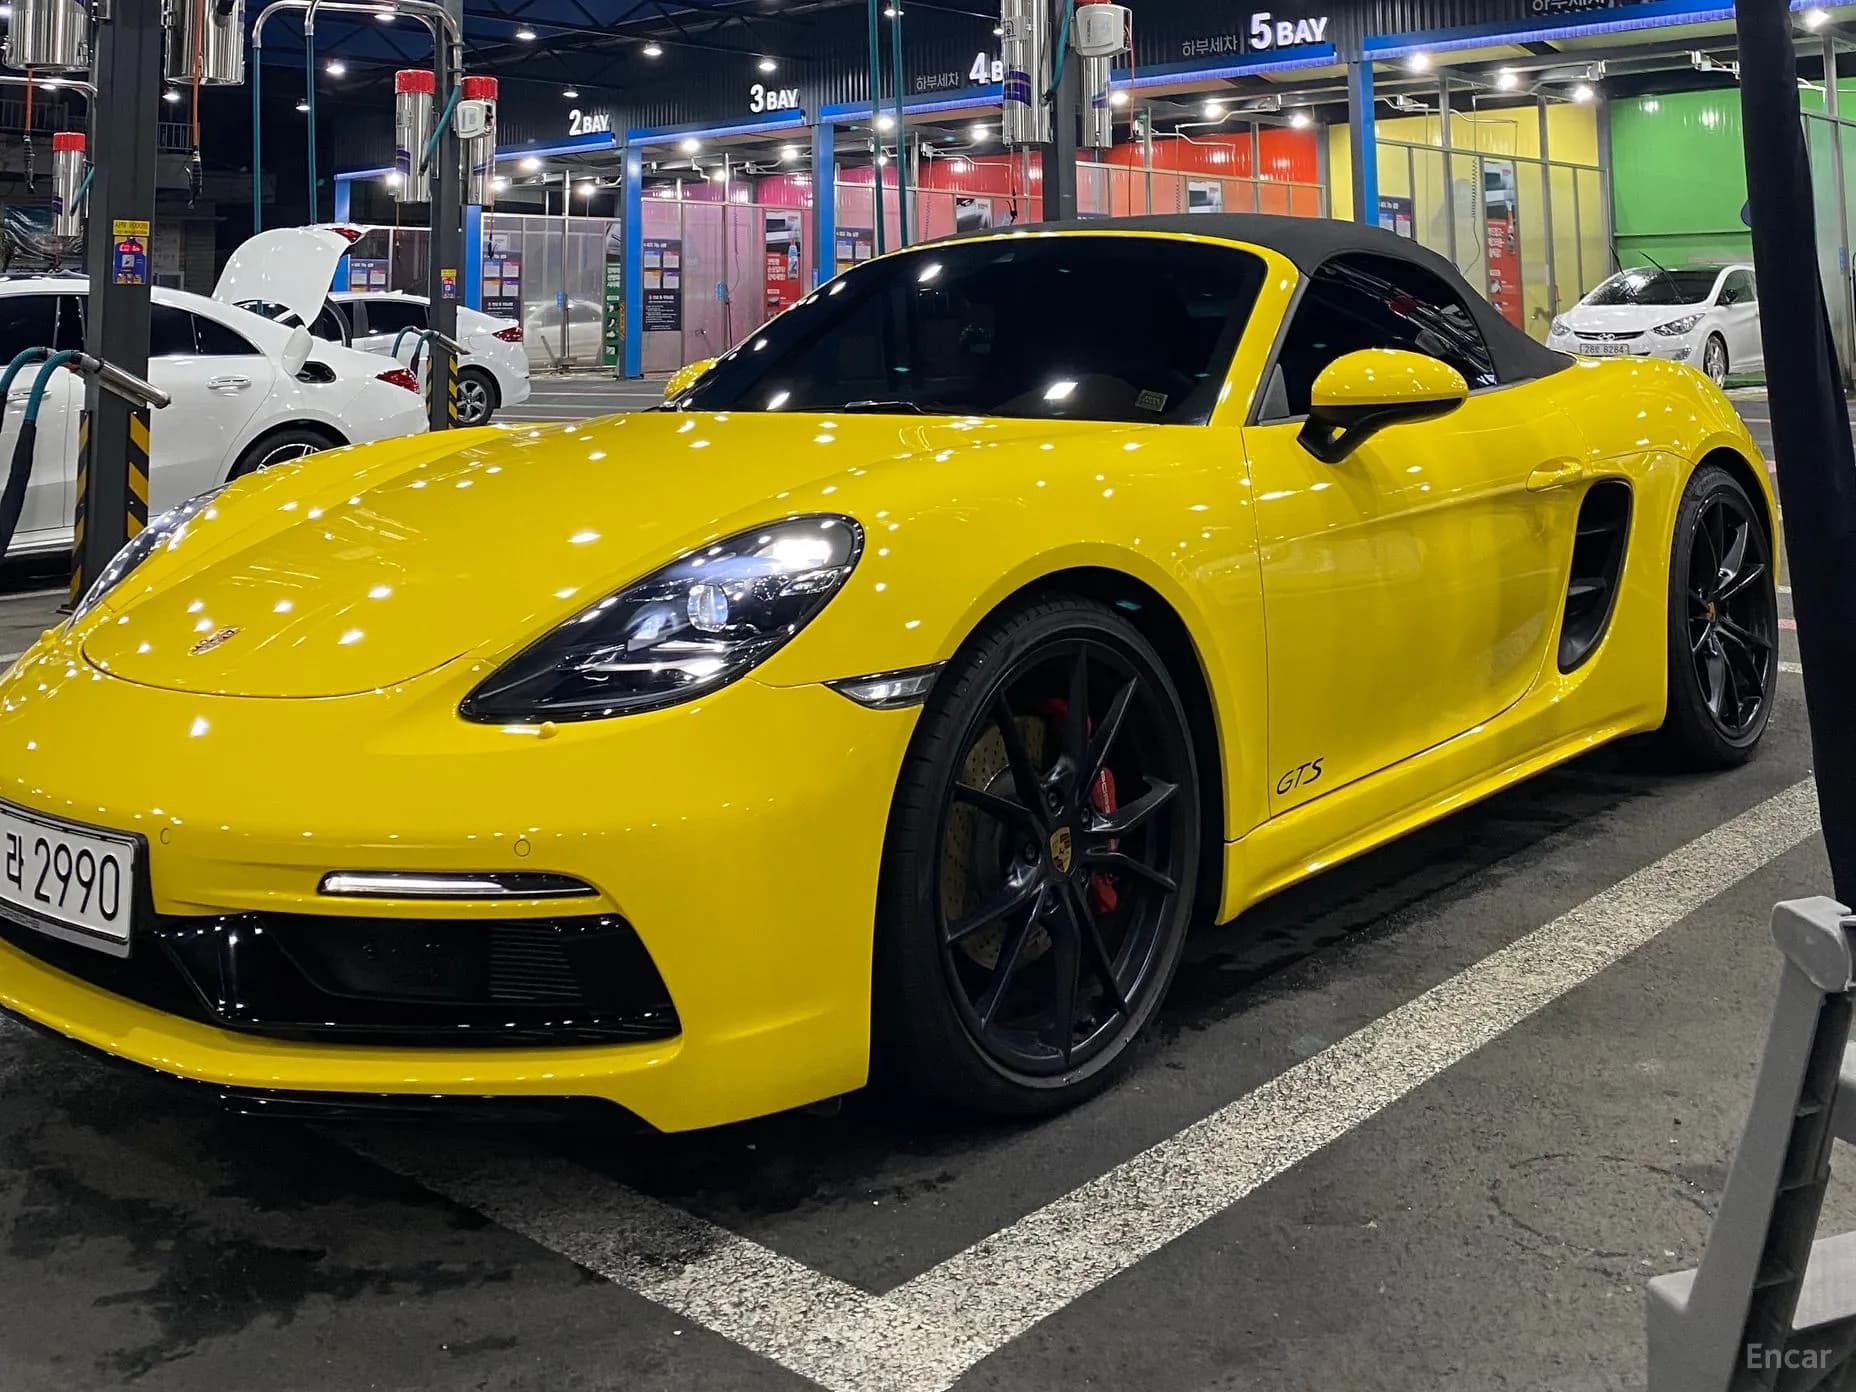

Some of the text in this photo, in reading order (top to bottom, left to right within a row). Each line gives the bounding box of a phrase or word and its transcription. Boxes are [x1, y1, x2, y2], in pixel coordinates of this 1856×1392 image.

[1181, 12, 1328, 56] 하부세차 5 BAY
[915, 72, 959, 90] 하부세차
[969, 52, 988, 84] 4
[750, 84, 799, 113] 3 BAY
[569, 109, 610, 136] 2 BAY
[1603, 345, 1624, 354] 8284
[1277, 757, 1324, 795] GTS
[34, 837, 120, 922] 2990
